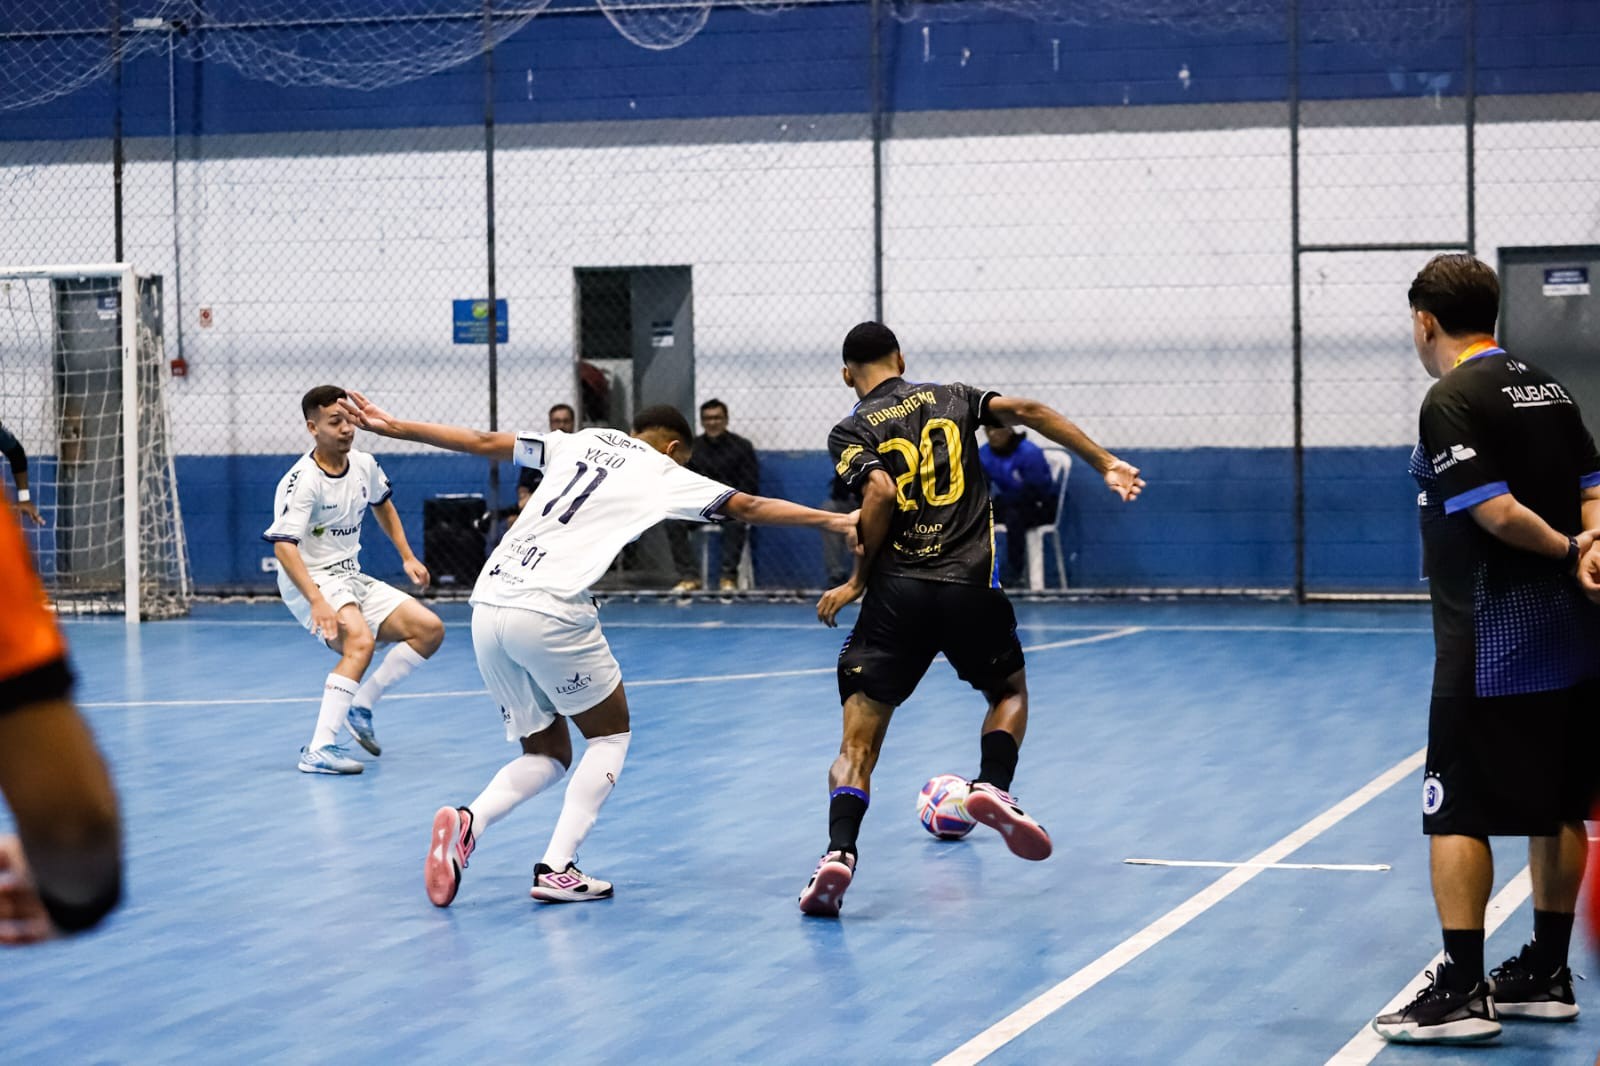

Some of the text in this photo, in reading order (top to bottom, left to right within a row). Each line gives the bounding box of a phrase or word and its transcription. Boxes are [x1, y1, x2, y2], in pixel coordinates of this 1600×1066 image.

[876, 418, 965, 512] 20
[541, 461, 608, 525] 11
[521, 546, 547, 570] 01
[555, 674, 592, 694] LEGACY
